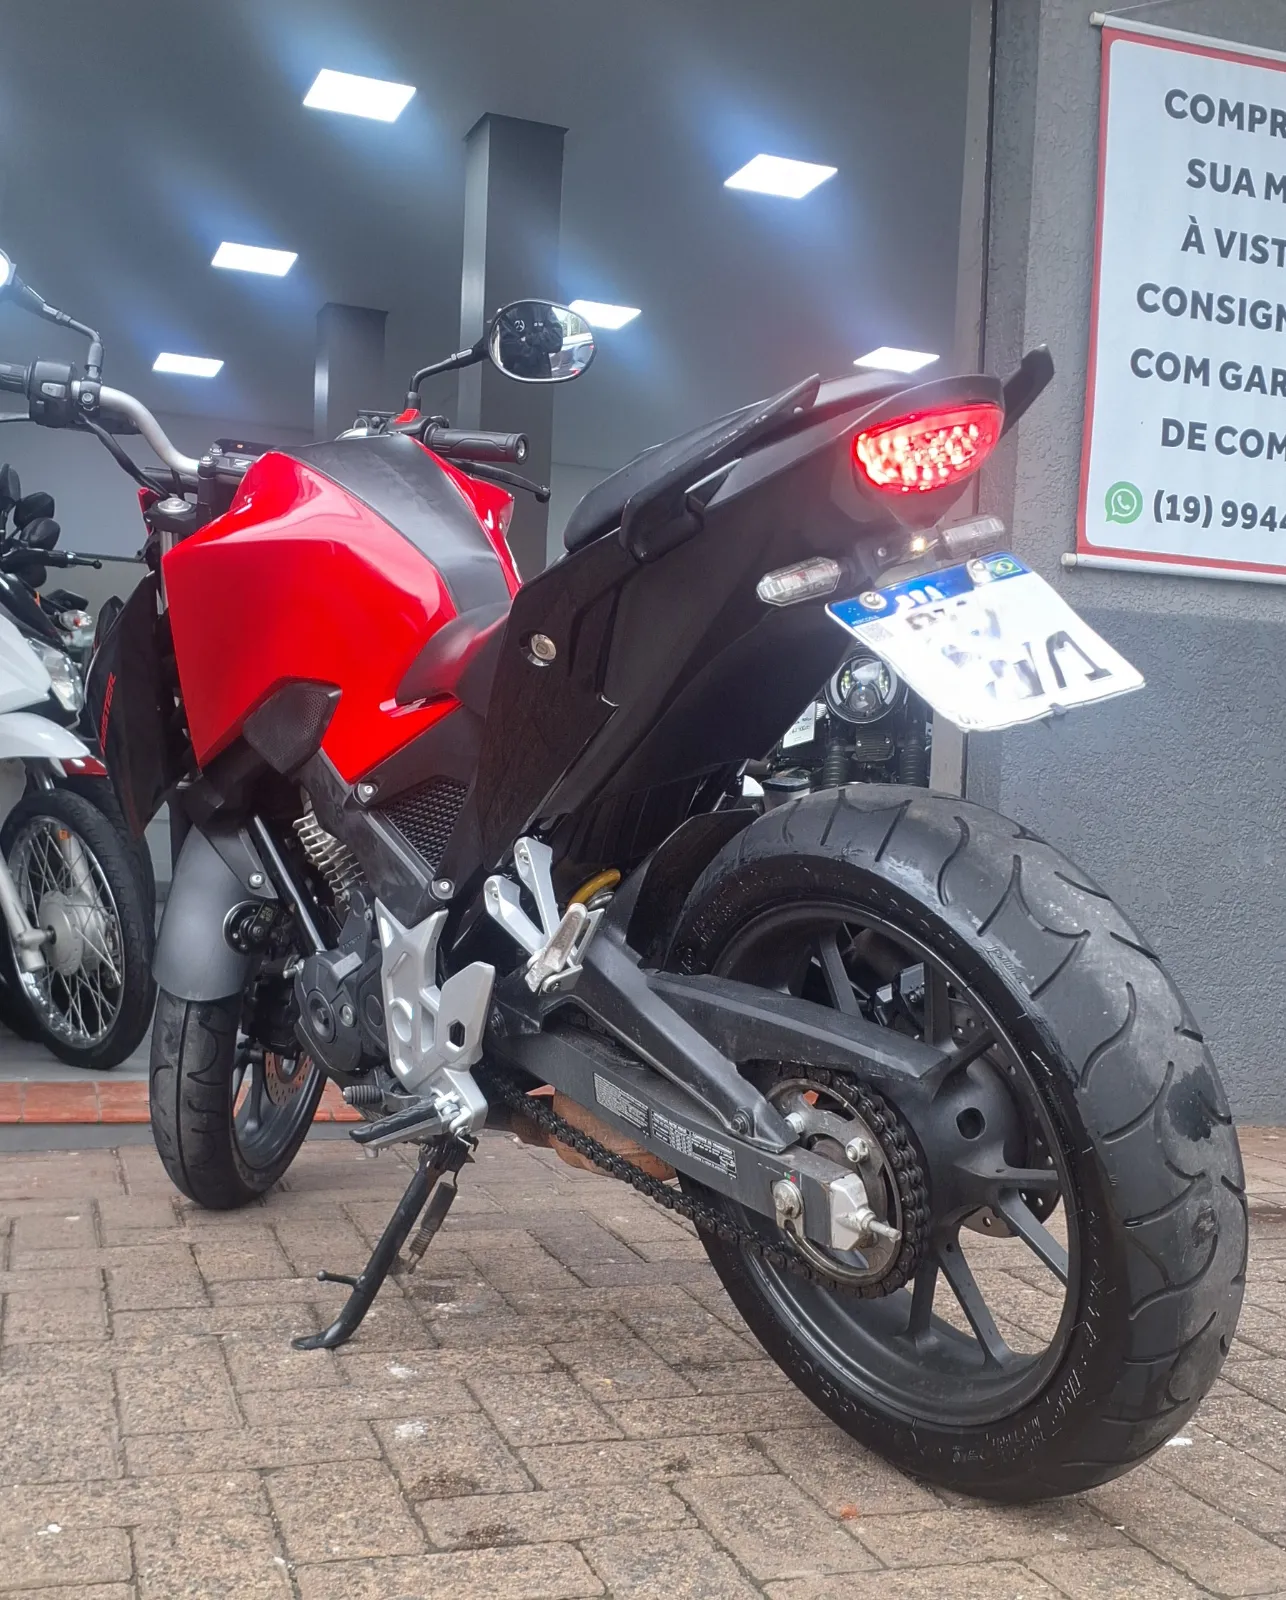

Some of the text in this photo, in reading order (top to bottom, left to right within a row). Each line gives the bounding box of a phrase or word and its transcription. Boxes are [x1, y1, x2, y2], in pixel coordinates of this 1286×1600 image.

[1165, 89, 1286, 138] COMPR
[1186, 159, 1286, 203] SUA M
[1181, 215, 1286, 267] À VIST
[1131, 349, 1286, 397] COM GAR
[1162, 418, 1286, 461] DE COM
[1154, 490, 1212, 528] (19)
